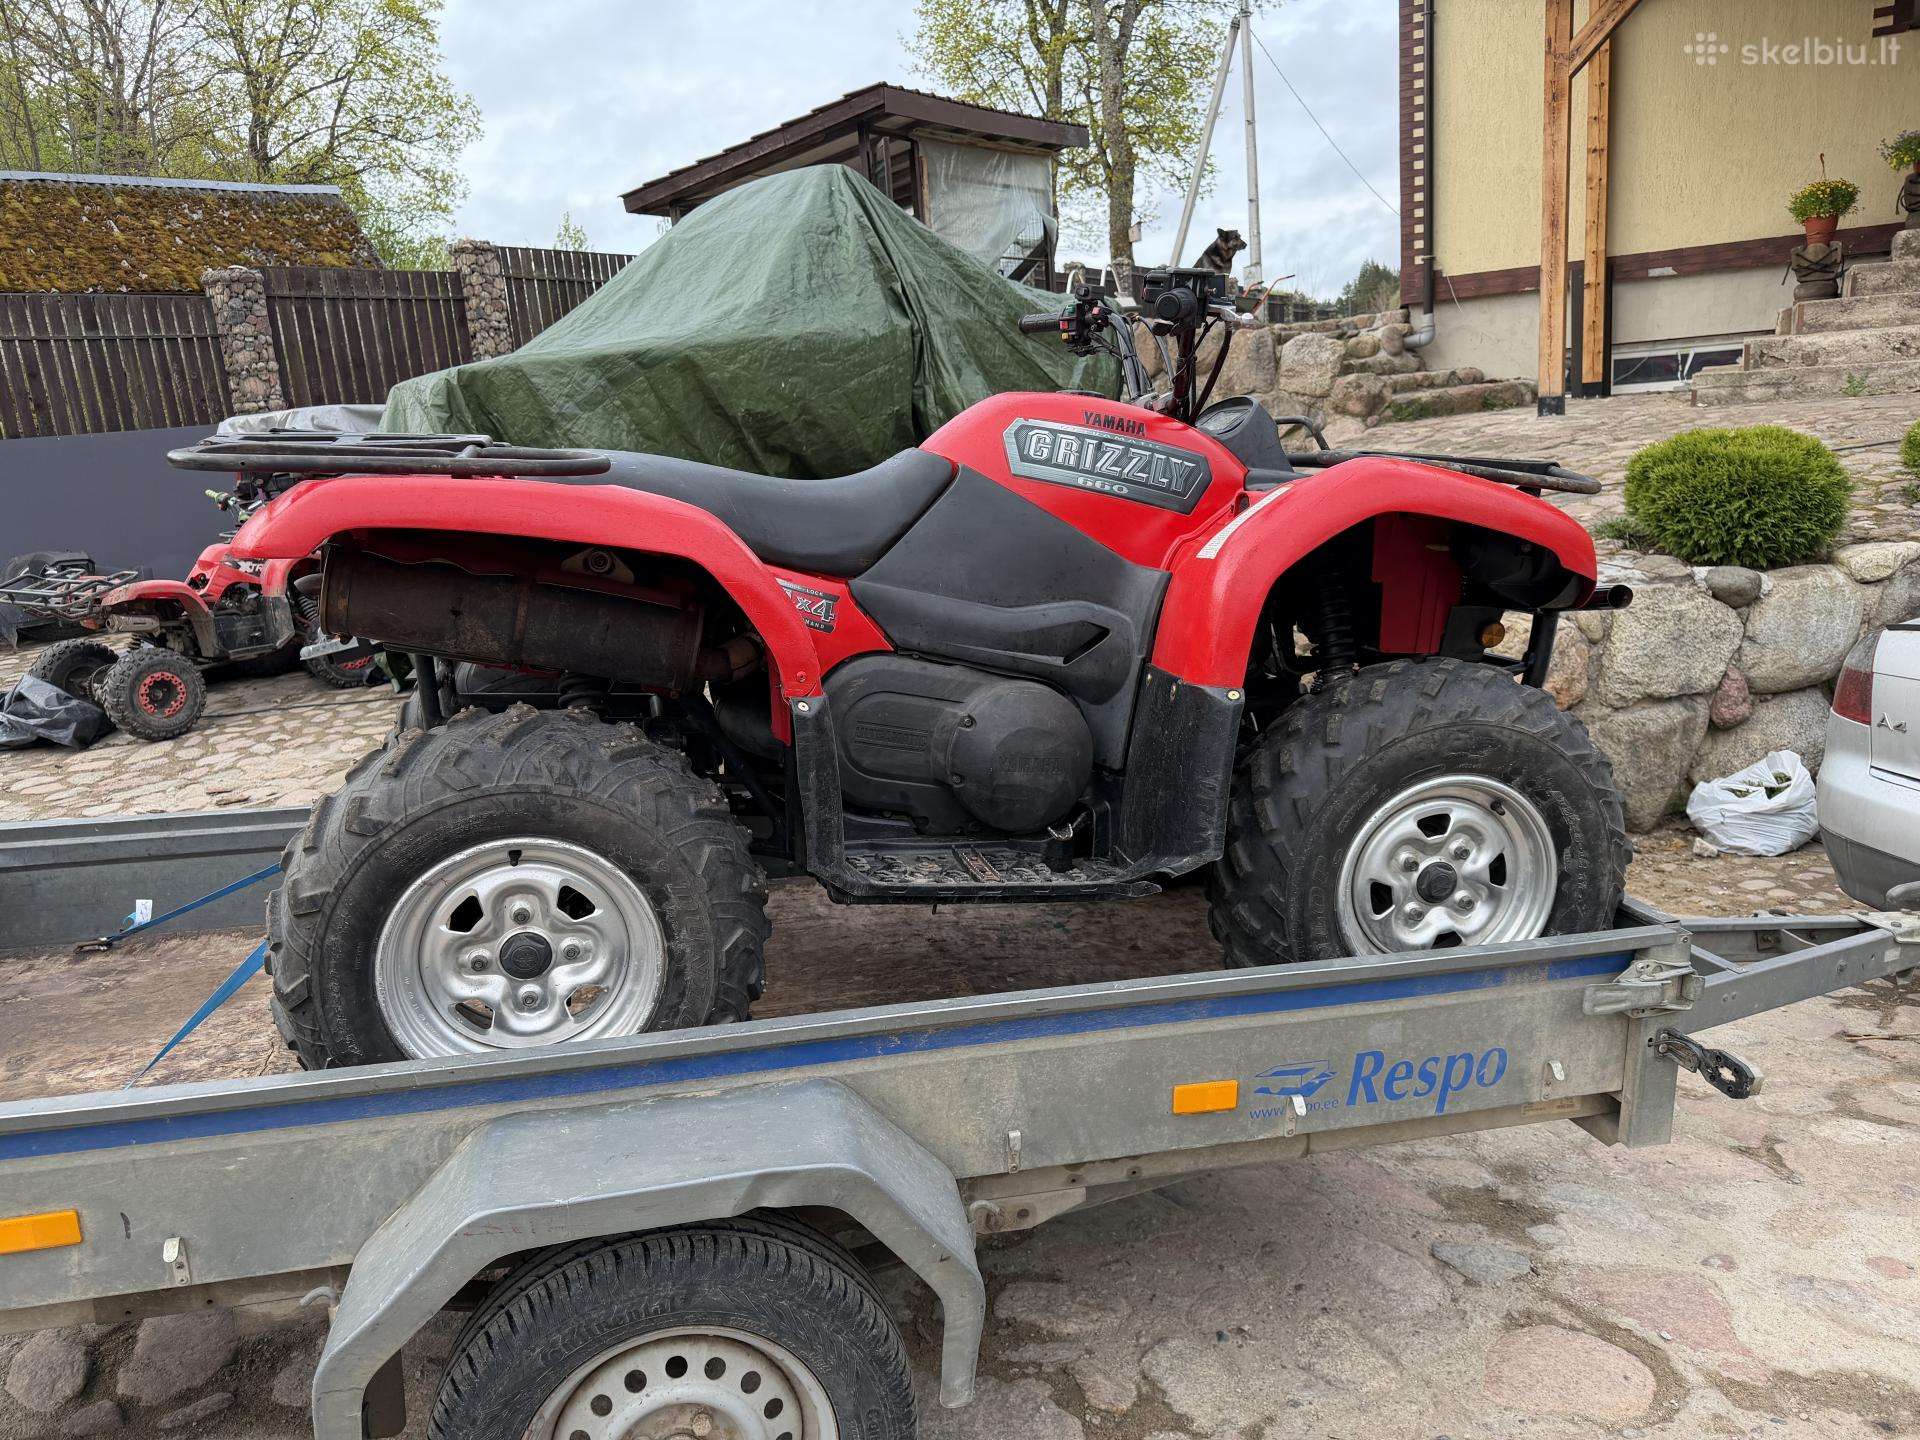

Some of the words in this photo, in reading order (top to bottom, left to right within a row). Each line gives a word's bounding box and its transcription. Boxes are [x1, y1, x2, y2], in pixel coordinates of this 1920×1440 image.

[1081, 410, 1147, 436] YAMAHA
[1023, 429, 1196, 492] GRIZZLY
[1076, 476, 1129, 494] 660
[784, 589, 836, 622] x4
[1877, 712, 1908, 734] A4
[1346, 1047, 1508, 1116] Respo
[1249, 1099, 1340, 1120] wwwpo.ee
